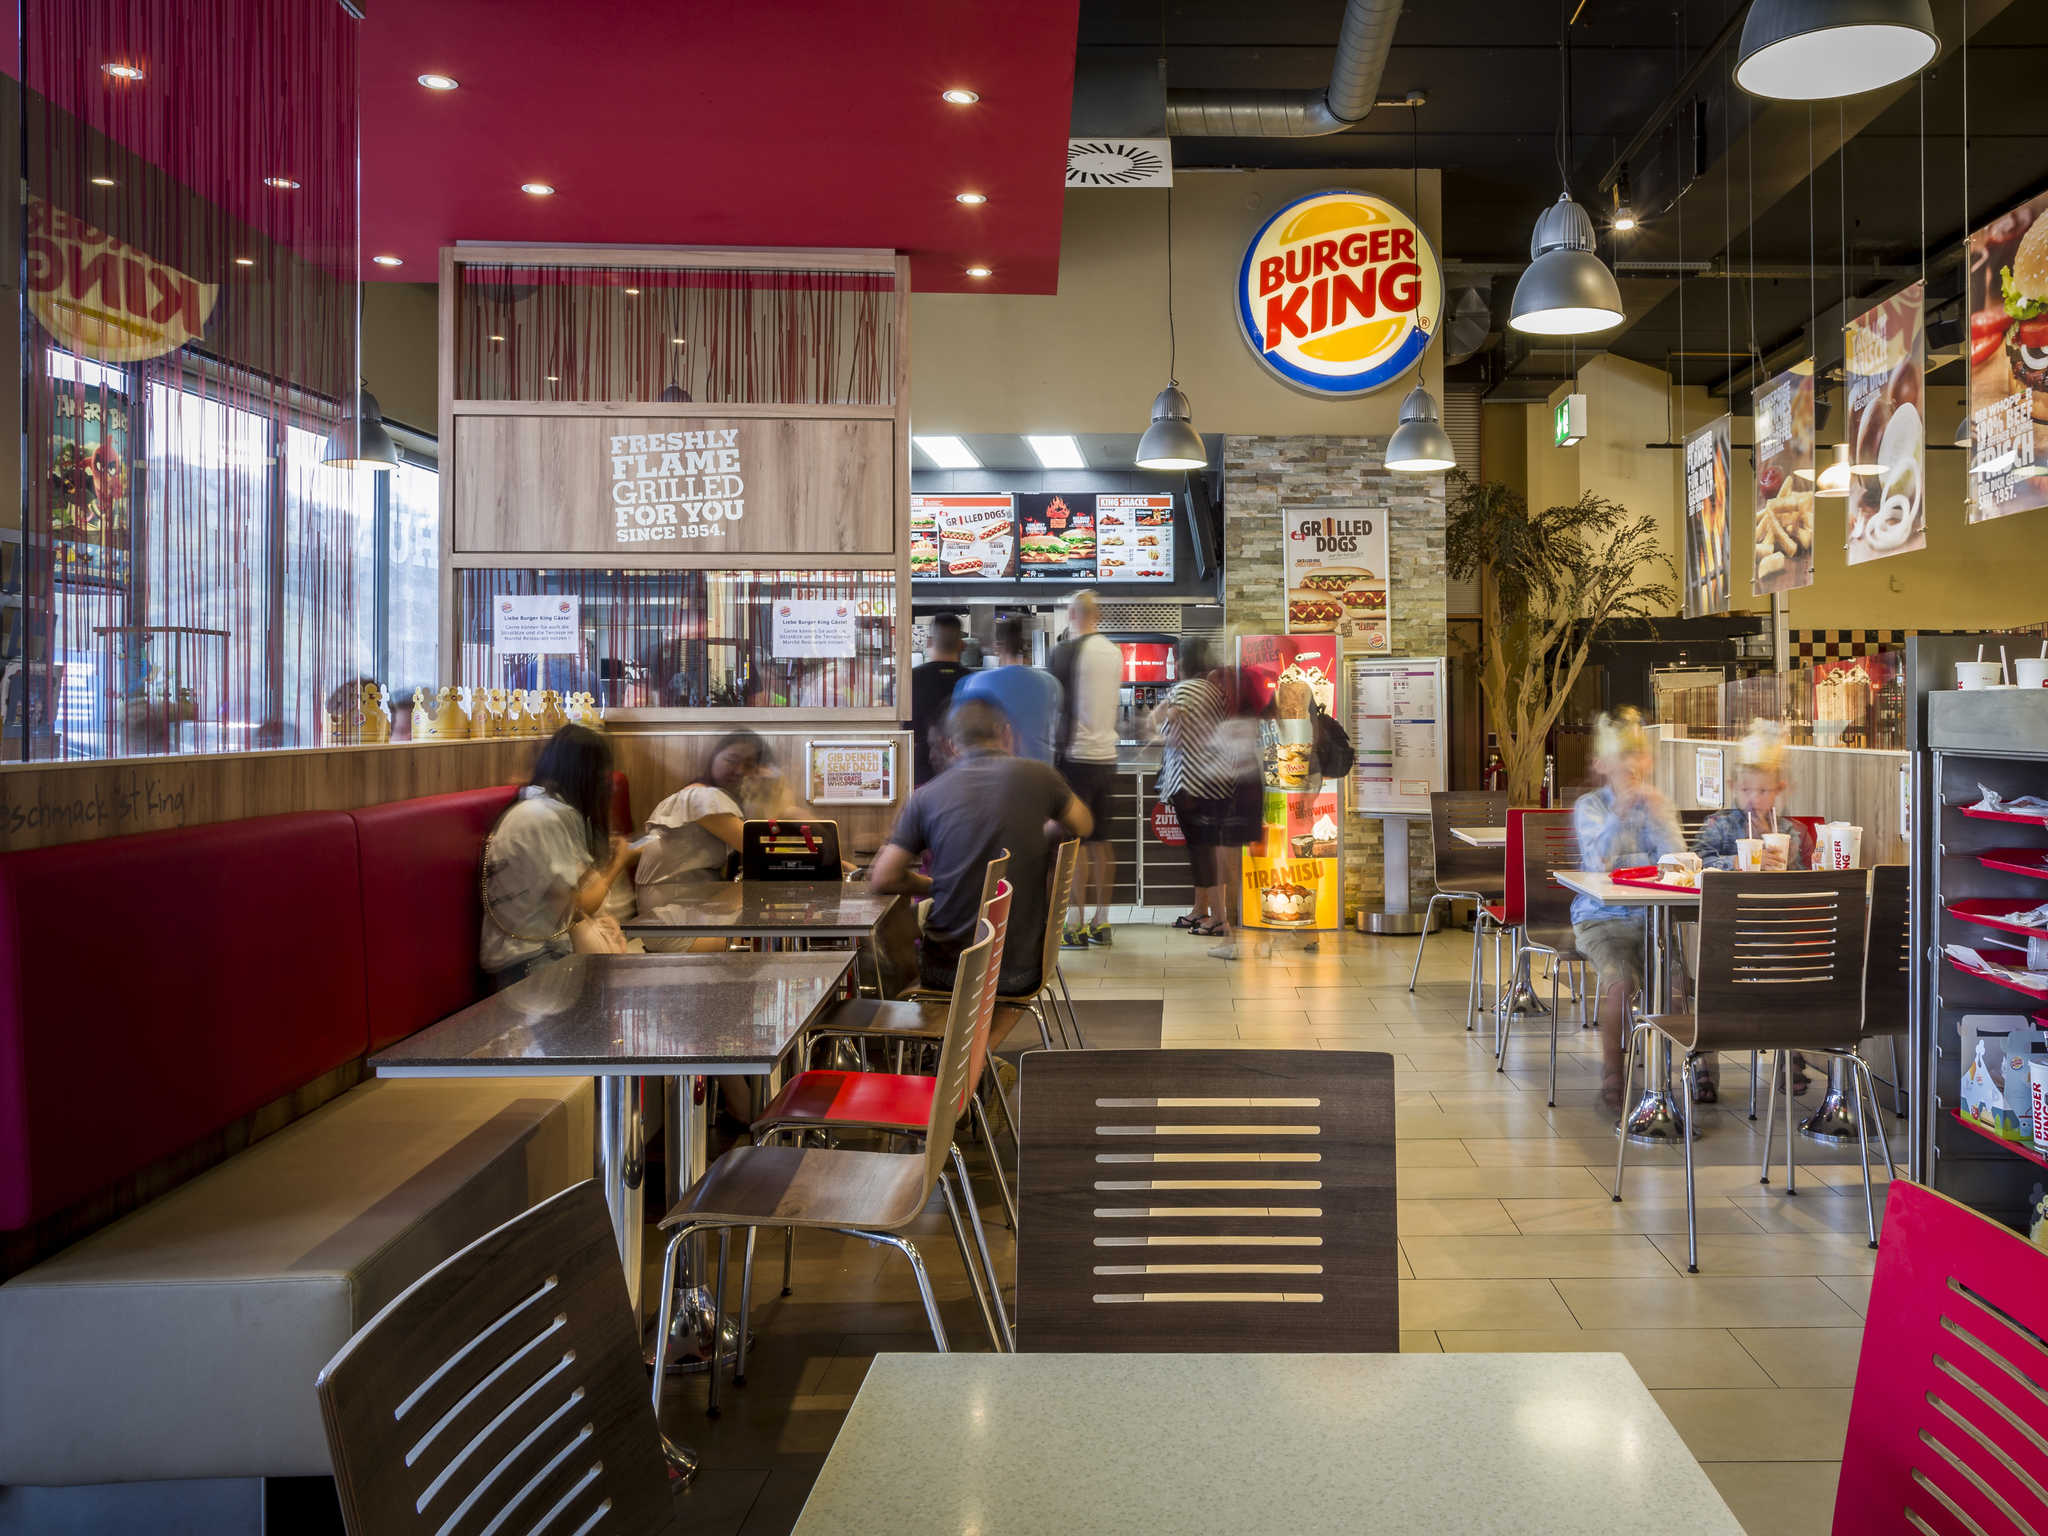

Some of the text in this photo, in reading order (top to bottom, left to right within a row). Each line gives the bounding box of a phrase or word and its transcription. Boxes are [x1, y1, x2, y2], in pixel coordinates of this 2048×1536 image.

[1260, 228, 1416, 297] BURGER
[1266, 262, 1422, 350] KING
[610, 429, 738, 454] FRESHLY
[611, 449, 740, 480] FLAME
[612, 475, 744, 505] GRILLED
[1100, 498, 1149, 507] KING SNACKS
[615, 500, 744, 527] FOR YOU
[984, 509, 1006, 520] DOGS
[616, 524, 726, 542] SINCE 1954.
[1316, 536, 1358, 553] DOGS
[1245, 860, 1325, 889] TIRAMISU
[2032, 1082, 2043, 1140] BURGER
